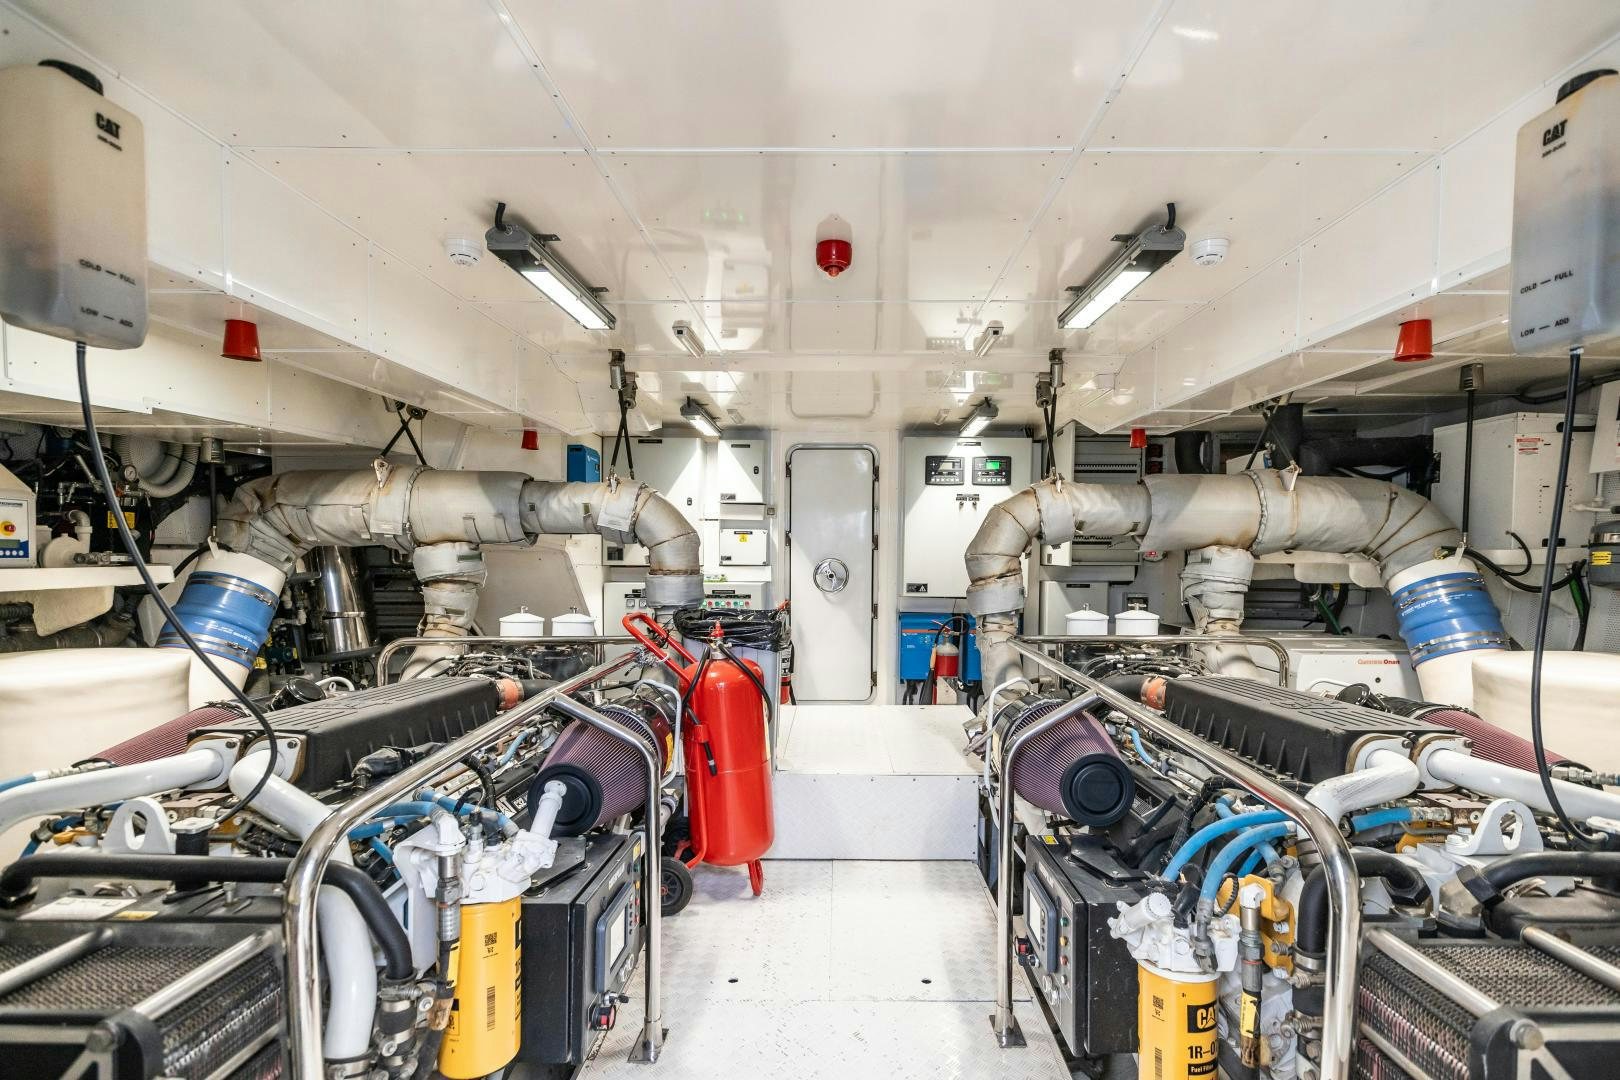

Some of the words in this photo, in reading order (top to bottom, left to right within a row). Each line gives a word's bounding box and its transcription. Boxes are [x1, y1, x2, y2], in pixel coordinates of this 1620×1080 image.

[95, 111, 121, 140] CAT
[1542, 118, 1568, 147] CAT
[79, 259, 102, 272] COLD
[1520, 282, 1538, 295] COLD
[1554, 269, 1574, 281] FULL
[80, 306, 99, 317] LOW
[1520, 327, 1536, 338] LOW
[1554, 317, 1570, 327] ADD
[1196, 1005, 1217, 1030] CA
